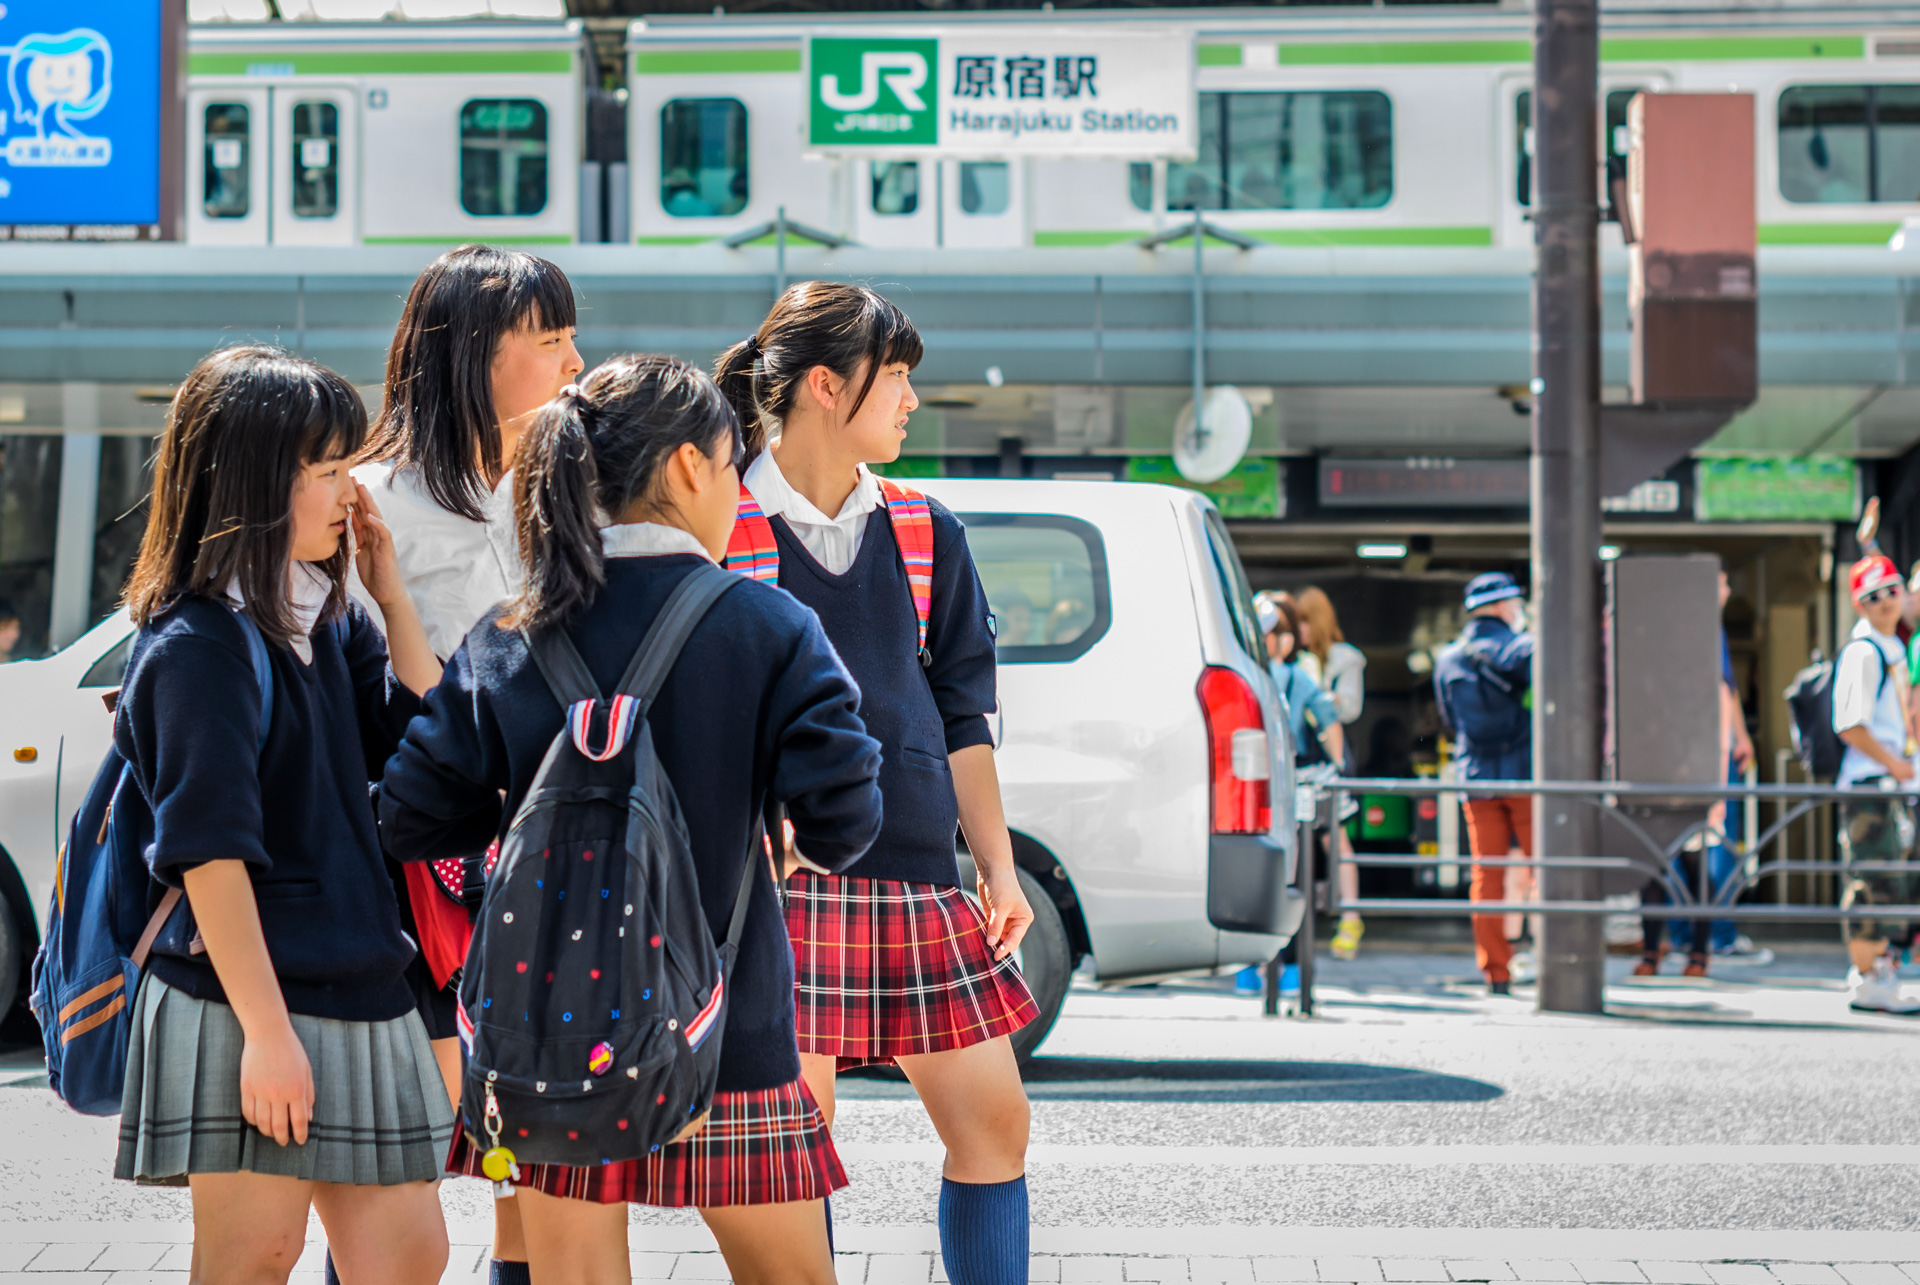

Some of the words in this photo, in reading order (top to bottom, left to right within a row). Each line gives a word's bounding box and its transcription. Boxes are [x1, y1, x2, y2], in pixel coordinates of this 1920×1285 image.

[820, 52, 928, 111] JR
[953, 55, 1097, 99] 原宿駅
[950, 110, 1072, 137] Harajuku
[1082, 110, 1178, 131] Station
